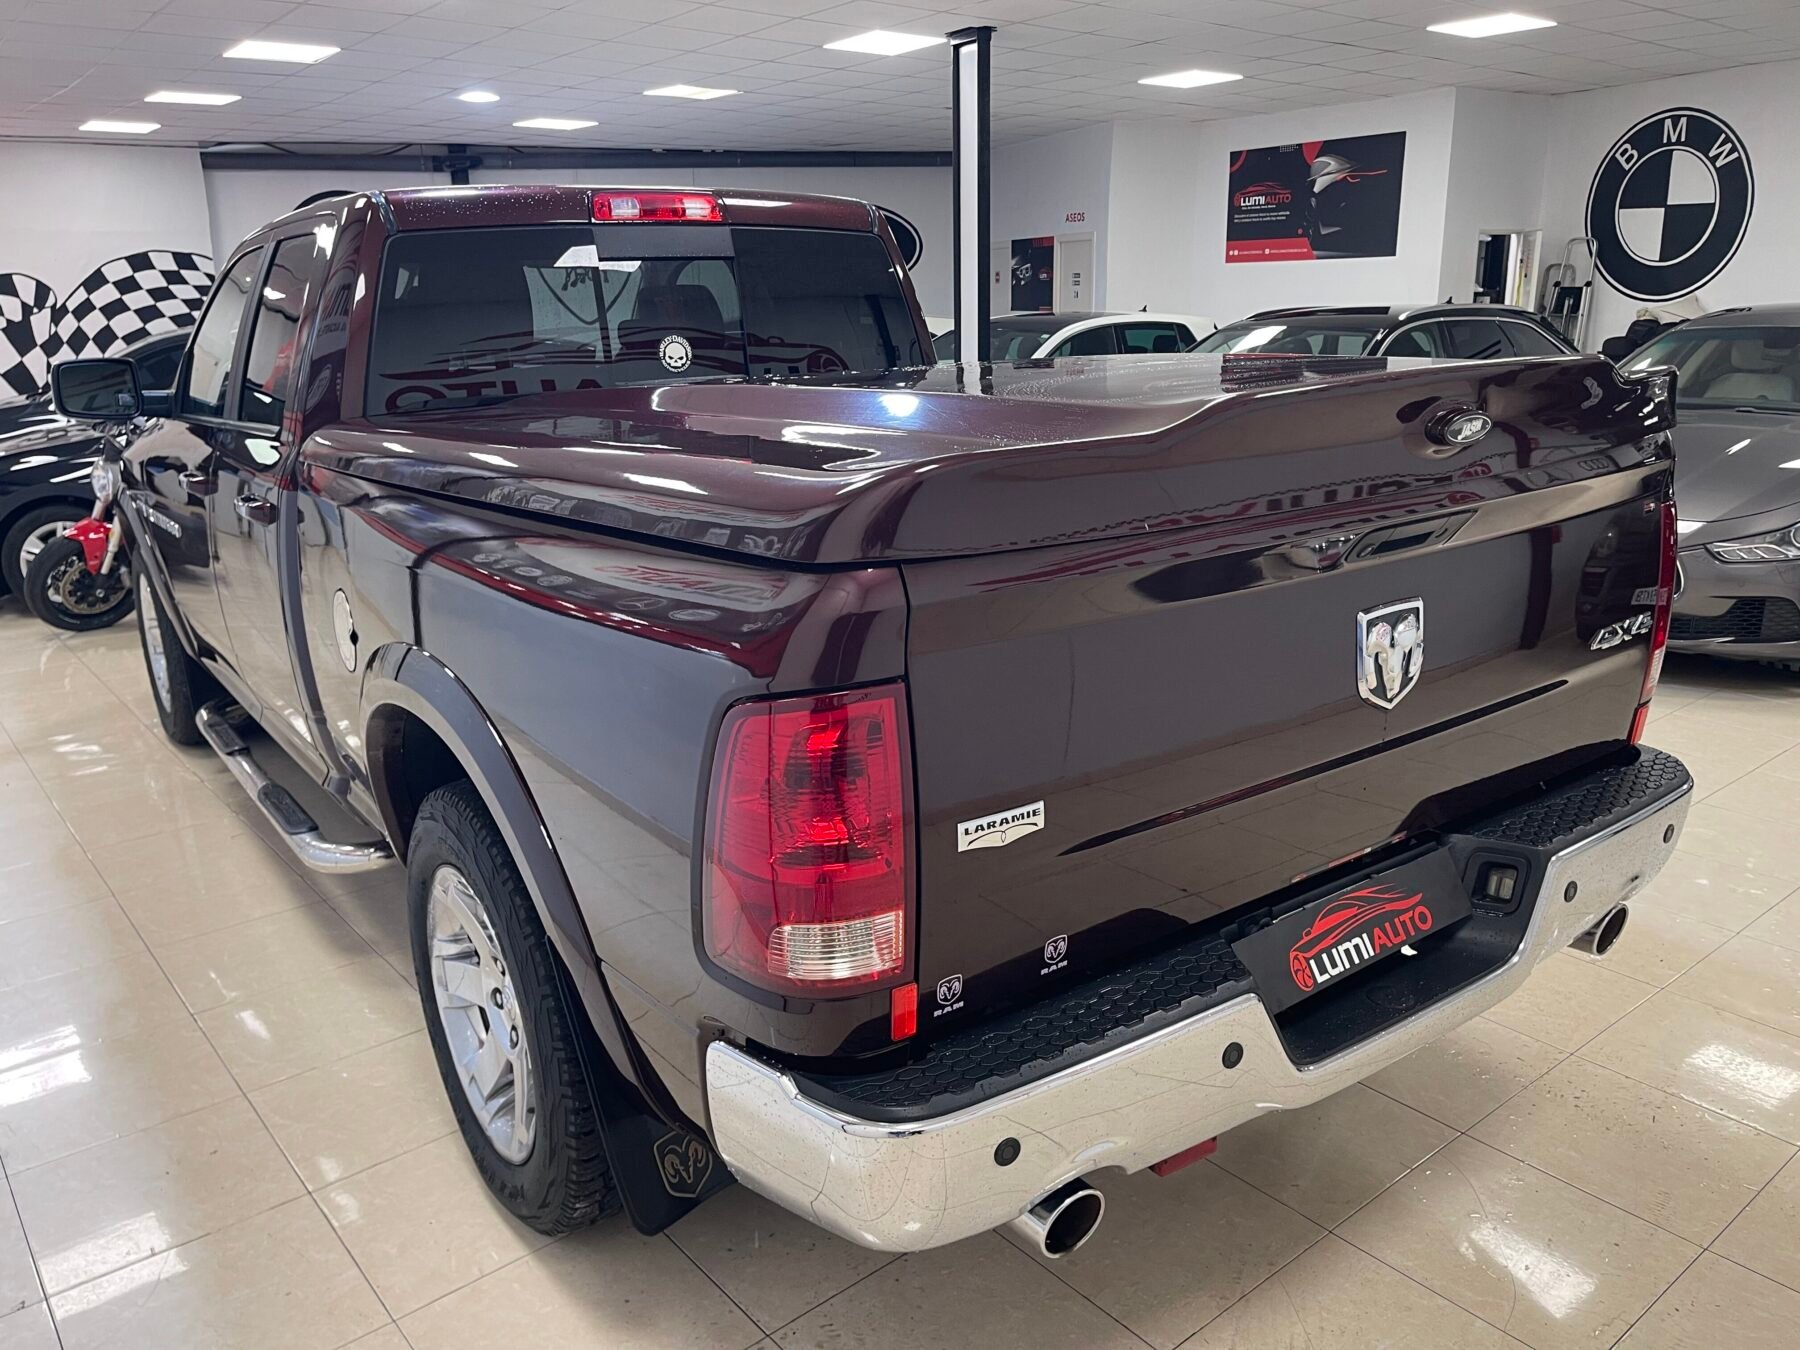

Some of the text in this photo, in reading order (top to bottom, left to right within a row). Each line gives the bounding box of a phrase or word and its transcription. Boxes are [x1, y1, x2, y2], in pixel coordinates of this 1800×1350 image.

[1614, 116, 1740, 171] BMW
[1064, 211, 1085, 223] ASEOS
[964, 807, 1041, 836] LARAMIE
[1309, 905, 1433, 984] LUMIAUTO
[1041, 960, 1068, 975] RAM
[933, 1001, 964, 1017] RAM
